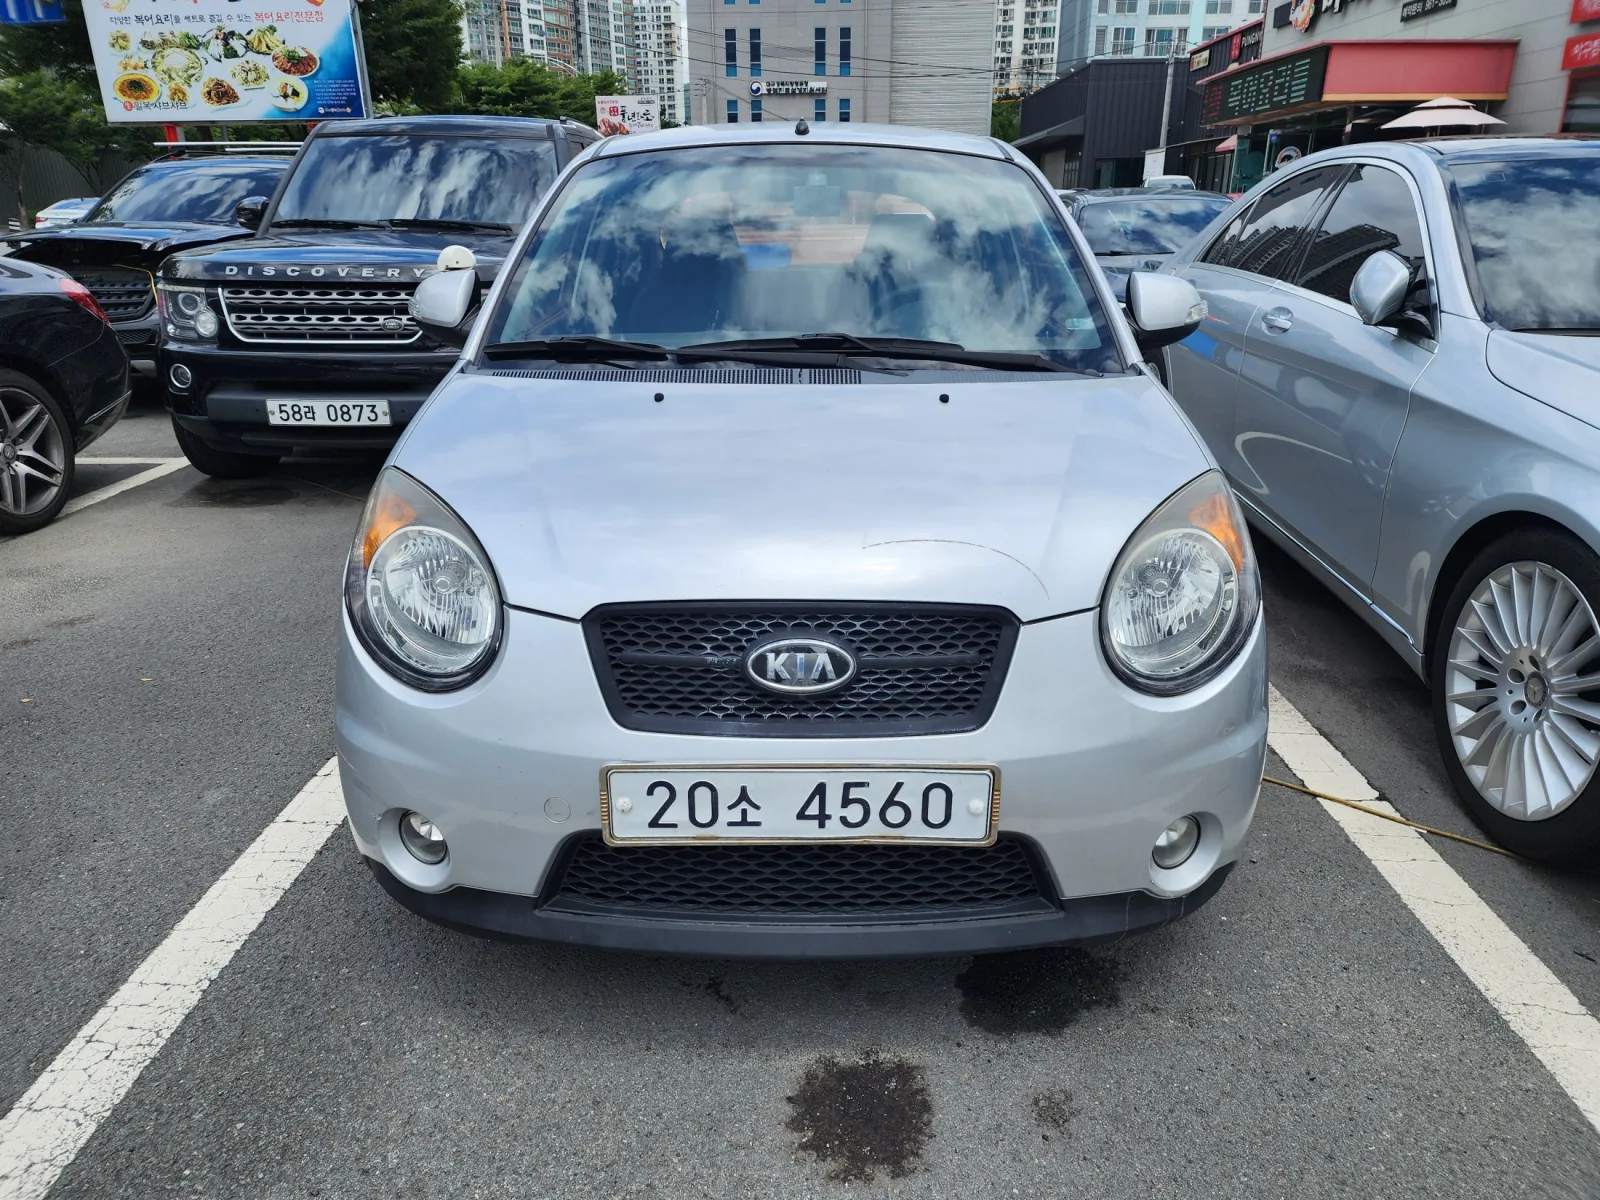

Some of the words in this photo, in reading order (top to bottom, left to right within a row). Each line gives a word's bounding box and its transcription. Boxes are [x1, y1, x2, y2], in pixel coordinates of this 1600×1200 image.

[110, 15, 132, 25] 다양한
[134, 13, 181, 26] 복어요리를
[183, 14, 207, 24] 세트로
[208, 14, 224, 24] 즐길
[226, 14, 234, 24] 수
[236, 13, 252, 24] 있는
[254, 11, 324, 24] 복어요리전문점
[225, 265, 426, 278] DISCOVERY
[278, 403, 316, 422] 58라
[326, 404, 379, 422] 0873
[765, 651, 836, 680] KIA
[645, 780, 762, 829] 20소
[795, 780, 954, 829] 4560
